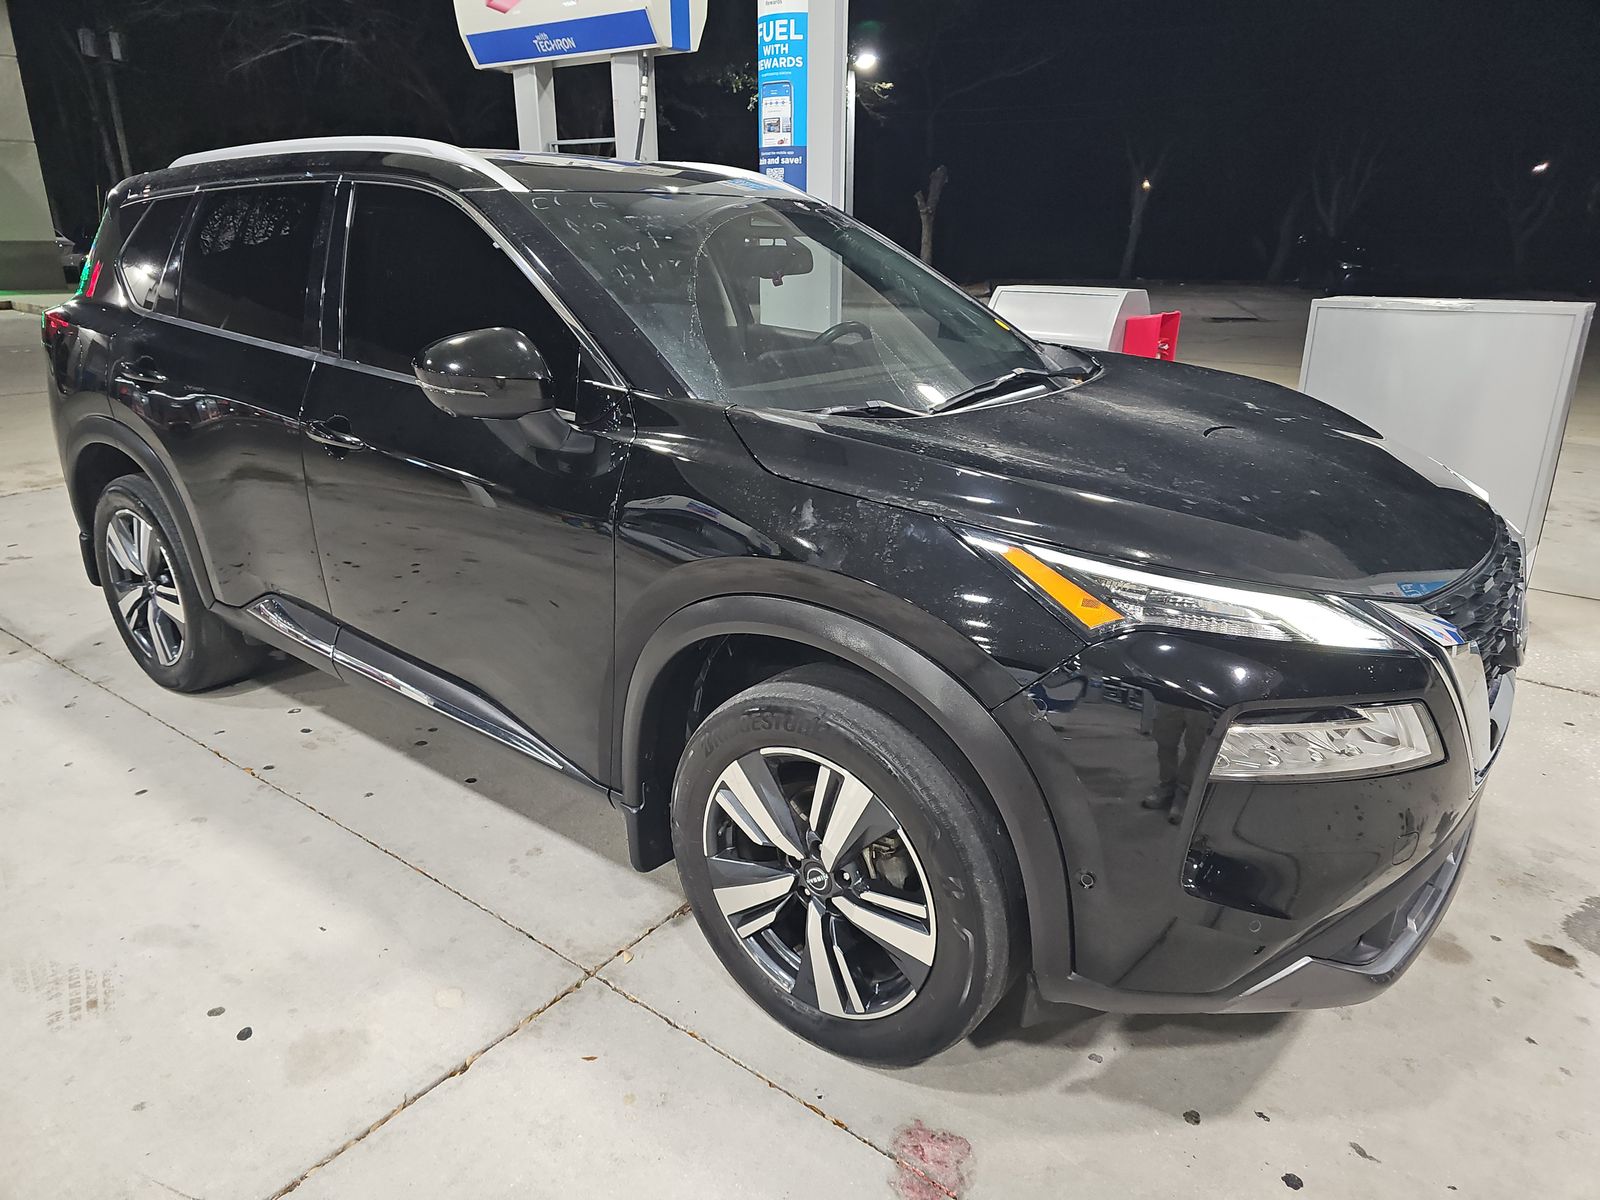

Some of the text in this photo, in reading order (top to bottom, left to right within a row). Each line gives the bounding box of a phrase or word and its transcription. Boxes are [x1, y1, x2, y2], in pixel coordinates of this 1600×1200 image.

[535, 32, 549, 41] with
[758, 19, 803, 44] FUEL
[532, 37, 576, 54] TECHRON
[763, 43, 788, 56] WITH
[767, 156, 779, 165] and
[780, 155, 802, 165] save!
